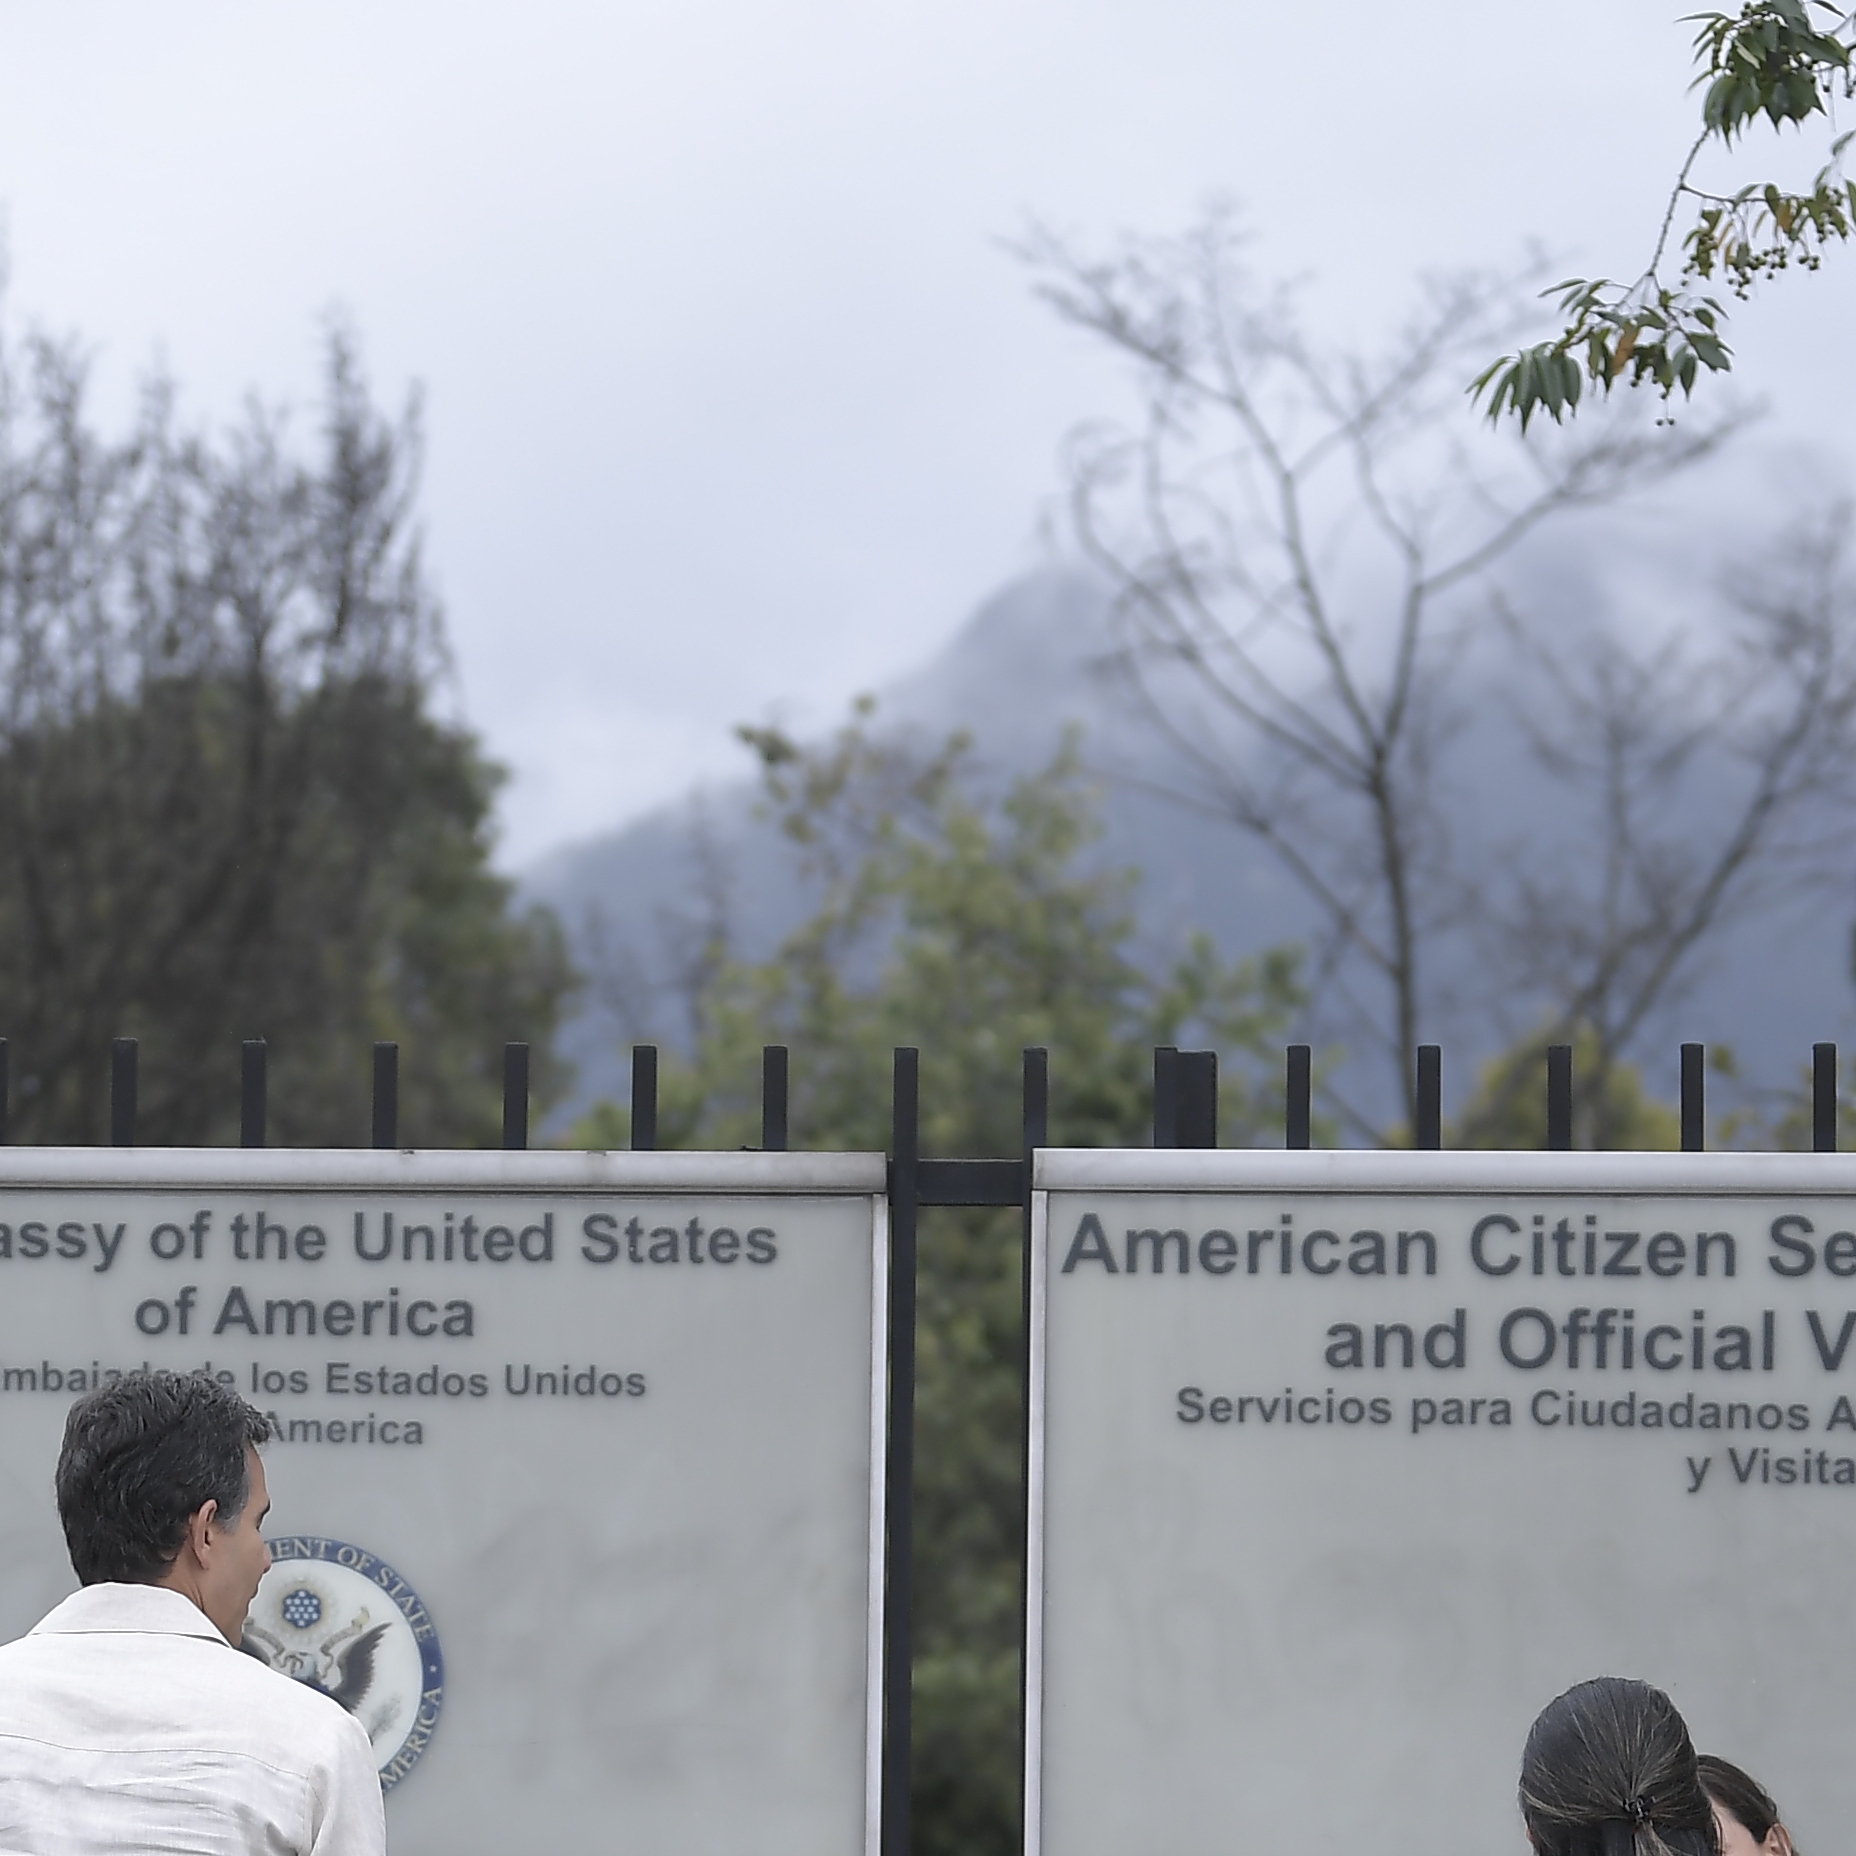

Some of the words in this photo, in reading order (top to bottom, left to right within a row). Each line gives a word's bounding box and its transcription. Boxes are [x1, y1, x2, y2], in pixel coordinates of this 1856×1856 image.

[149, 1209, 213, 1261] of
[229, 1211, 327, 1263] the
[353, 1211, 554, 1264] United
[581, 1213, 778, 1266] States
[1060, 1213, 1438, 1278] American
[1469, 1213, 1737, 1279] Citizen
[134, 1285, 198, 1337] of
[212, 1286, 475, 1339] America
[1324, 1307, 1467, 1371] and
[1498, 1307, 1776, 1373] Official
[251, 1362, 310, 1395] los
[325, 1362, 489, 1399] Estados
[504, 1364, 647, 1398] Unidos
[1176, 1386, 1393, 1426] Servicios
[1411, 1398, 1512, 1435] para
[1530, 1389, 1811, 1433] Ciudadanos
[1686, 1456, 1712, 1494] y
[337, 1546, 376, 1573] OF
[375, 1566, 435, 1643] STATE
[379, 1686, 442, 1790] MERICA
